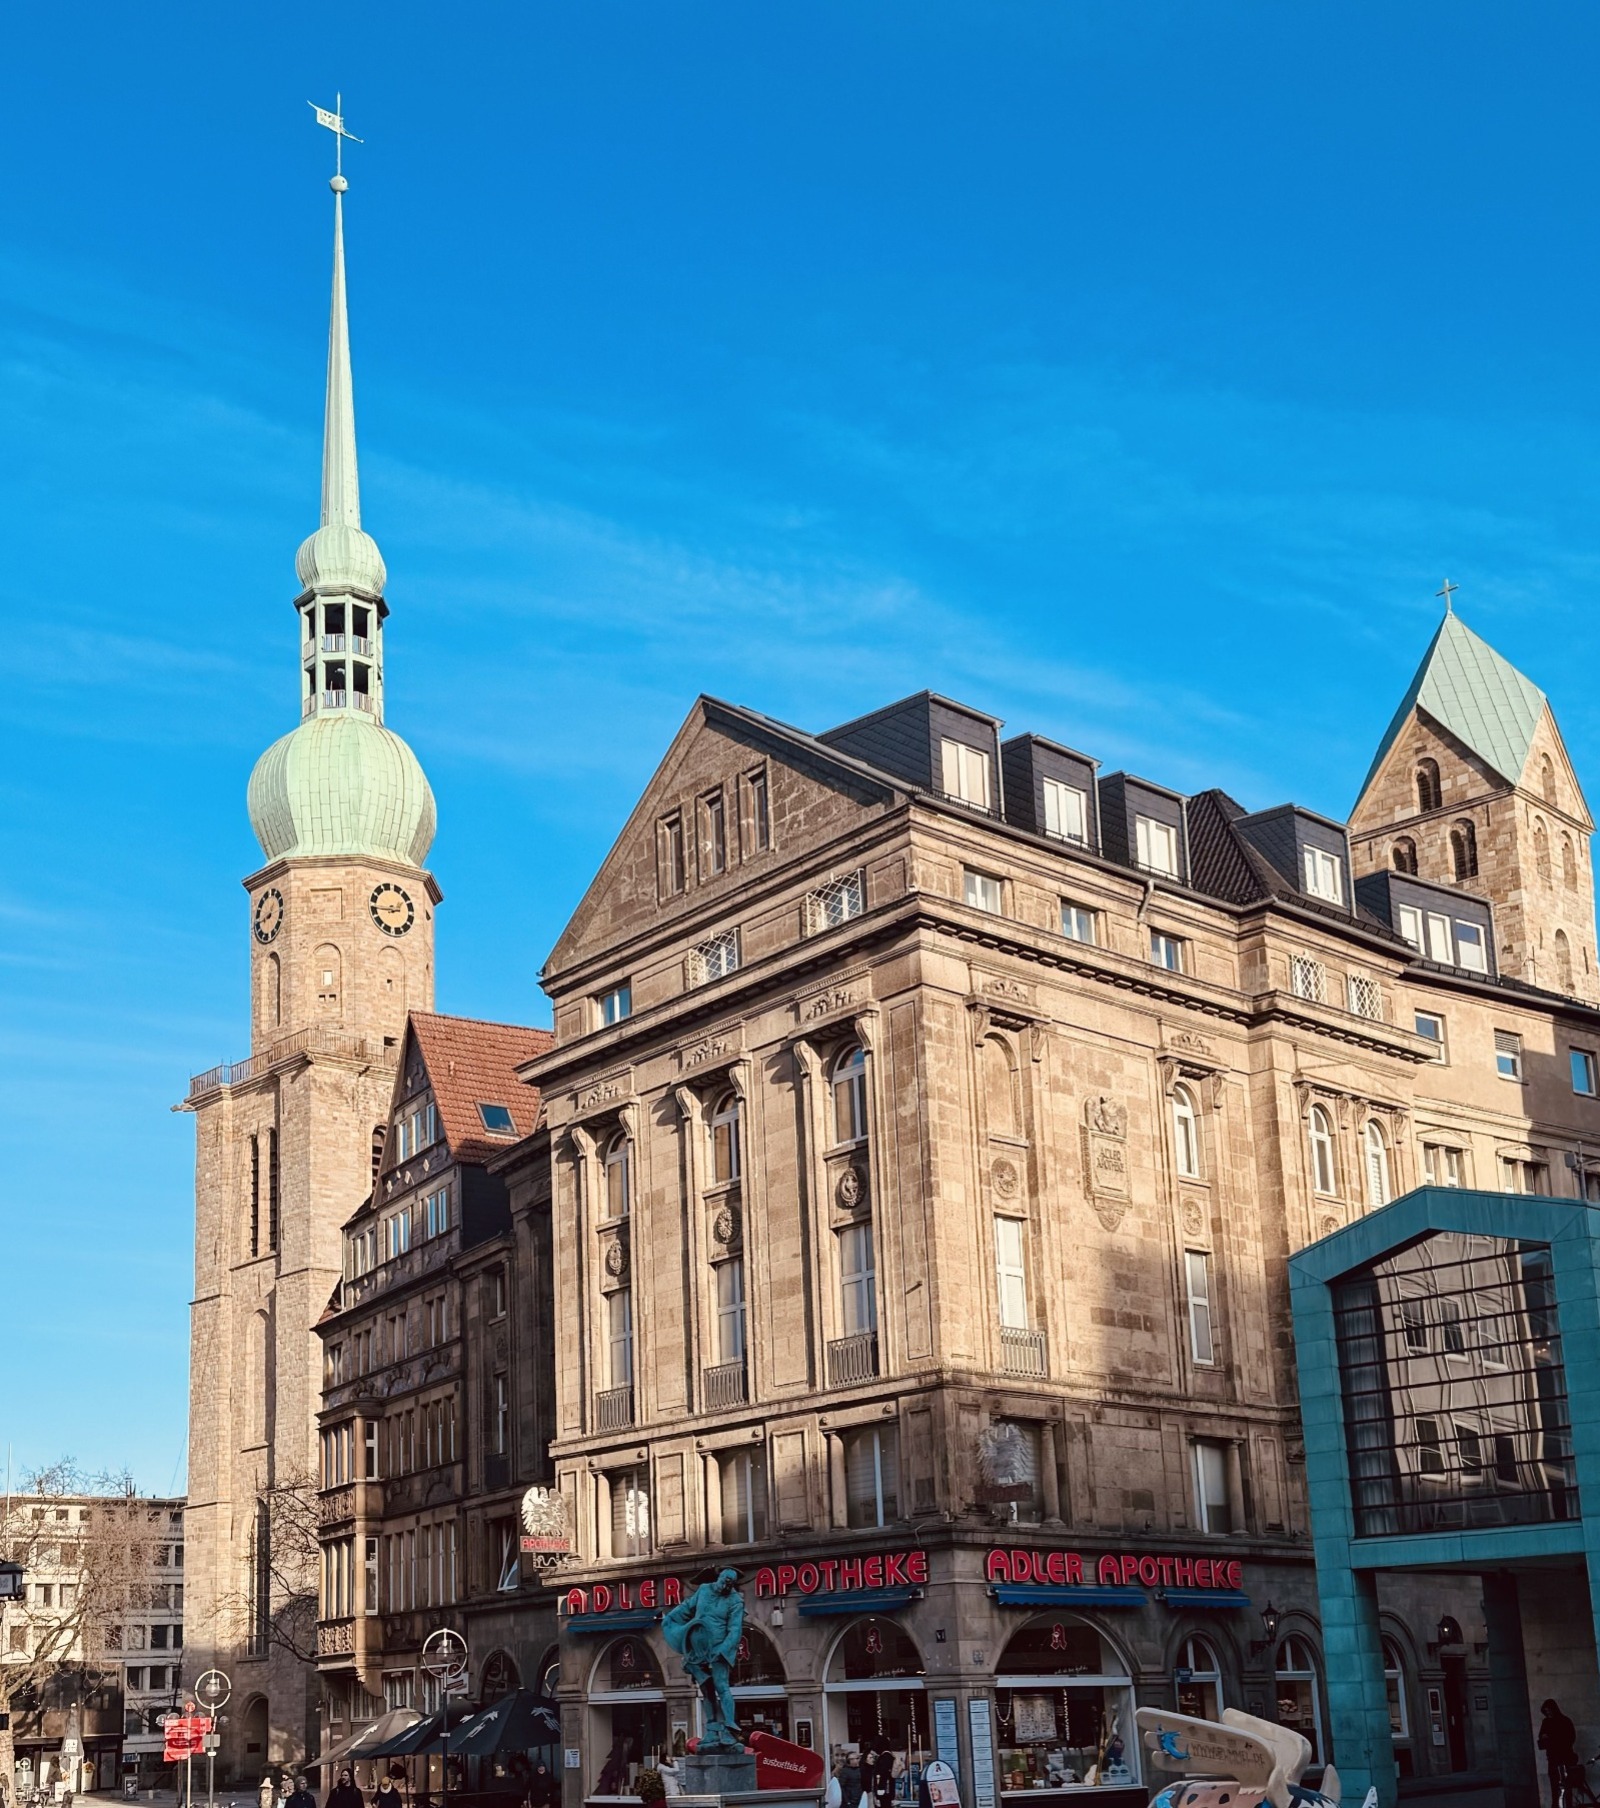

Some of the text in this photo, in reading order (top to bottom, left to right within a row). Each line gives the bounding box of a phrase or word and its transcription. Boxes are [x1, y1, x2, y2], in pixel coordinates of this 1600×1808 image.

[567, 1551, 928, 1614] ADLER APOTHEKE
[987, 1549, 1243, 1589] ADLER APOTHEKE
